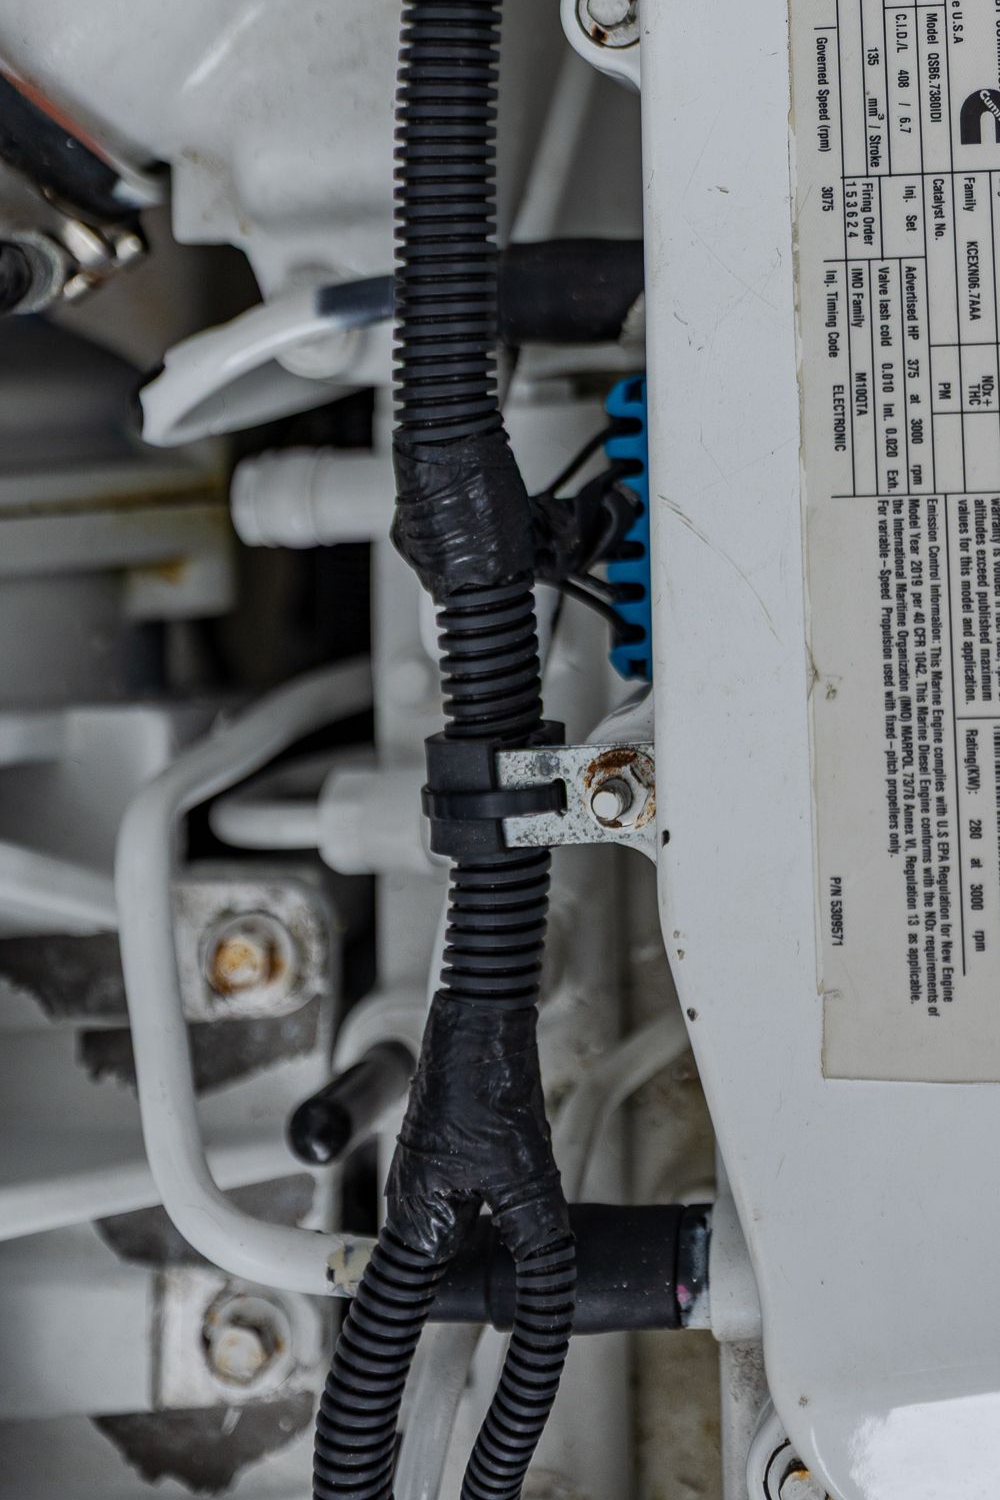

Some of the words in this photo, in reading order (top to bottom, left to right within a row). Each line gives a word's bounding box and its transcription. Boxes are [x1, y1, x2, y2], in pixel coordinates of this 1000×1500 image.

[926, 12, 938, 44] Model
[816, 37, 829, 85] Governed
[867, 47, 879, 65] 135
[897, 69, 909, 88] 408
[815, 89, 830, 120] Speed
[816, 124, 831, 152] (rpm)
[899, 117, 911, 133] 6.7
[868, 134, 882, 167] Stroke
[821, 186, 833, 211] 3075
[859, 182, 874, 212] Firing
[902, 185, 916, 202] Inj.
[930, 178, 945, 219] Catalyst
[961, 177, 976, 211] Family
[862, 216, 875, 245] Order
[905, 214, 917, 231] Set
[934, 223, 946, 240] No.
[823, 270, 837, 287] Inj.
[851, 268, 863, 288] IMO
[877, 266, 890, 295] Valve
[966, 241, 980, 320] KCEXN06.7AAA
[904, 266, 918, 320] Advertised
[823, 291, 838, 327] Timing
[849, 292, 864, 327] Family
[879, 299, 891, 320] lash
[827, 331, 840, 357] Code
[879, 324, 892, 346] cold
[907, 325, 919, 340] HP
[881, 362, 894, 392] 0.010
[906, 359, 919, 378] 375
[909, 394, 920, 404] at
[938, 382, 951, 399] PM
[968, 383, 980, 405] THC
[832, 384, 846, 451] ELECTRONIC
[882, 403, 894, 421] Int.
[885, 427, 898, 457] 0.020
[910, 418, 923, 444] 3000
[886, 469, 898, 492] Exh.
[909, 464, 921, 484] rpm
[926, 498, 939, 541] Emission
[957, 499, 970, 534] values
[973, 499, 988, 545] altitudes
[959, 537, 972, 552] for
[928, 545, 940, 580] Control
[959, 556, 972, 576] this
[975, 549, 989, 586] exceed
[960, 580, 974, 613] model
[929, 584, 942, 643] Information:
[962, 617, 975, 636] and
[975, 591, 991, 644] published
[929, 646, 942, 667] This
[960, 641, 977, 704] application.
[979, 648, 994, 701] maximum
[930, 670, 943, 705] Marine
[916, 706, 929, 741] Marine
[930, 709, 944, 743] Engine
[917, 744, 930, 775] Diesel
[931, 746, 946, 792] complies
[916, 779, 932, 813] Engine
[935, 795, 947, 816] with
[920, 817, 933, 863] conforms
[968, 819, 982, 839] 280
[937, 841, 949, 862] EPA
[970, 858, 982, 868] at
[830, 877, 841, 896] P/N
[922, 867, 934, 887] with
[923, 891, 935, 907] the
[935, 865, 951, 919] Regulation
[970, 884, 983, 910] 3000
[830, 900, 843, 945] 5309571
[924, 911, 936, 931] NOx
[940, 923, 952, 937] for
[940, 940, 953, 963] New
[972, 930, 985, 951] rpm
[923, 935, 938, 1003] requirements
[939, 967, 954, 1002] Engine
[927, 1006, 939, 1016] of
